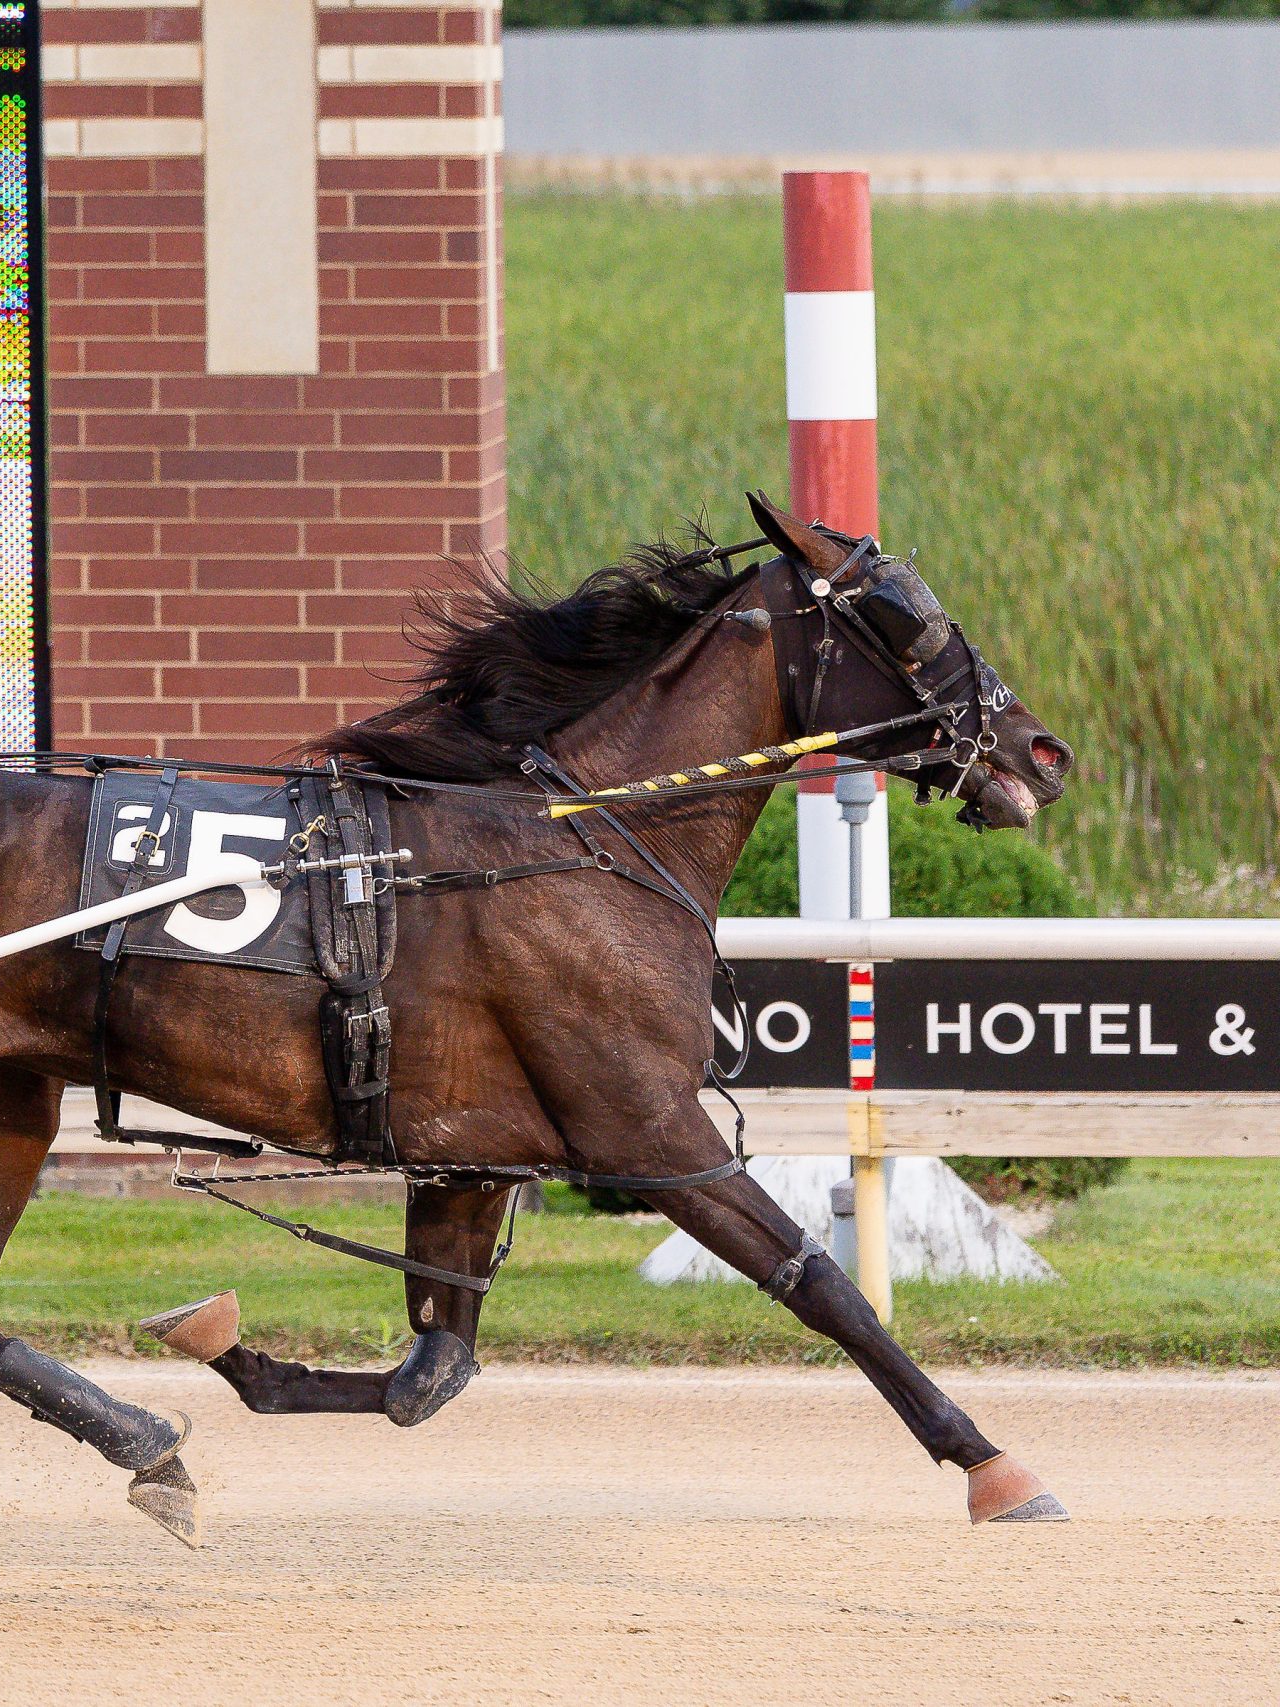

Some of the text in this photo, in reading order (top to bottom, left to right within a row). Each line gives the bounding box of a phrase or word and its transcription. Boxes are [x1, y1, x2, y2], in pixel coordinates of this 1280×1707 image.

[163, 810, 286, 954] 5
[926, 1002, 1179, 1055] HOTEL
[1208, 1003, 1257, 1056] &
